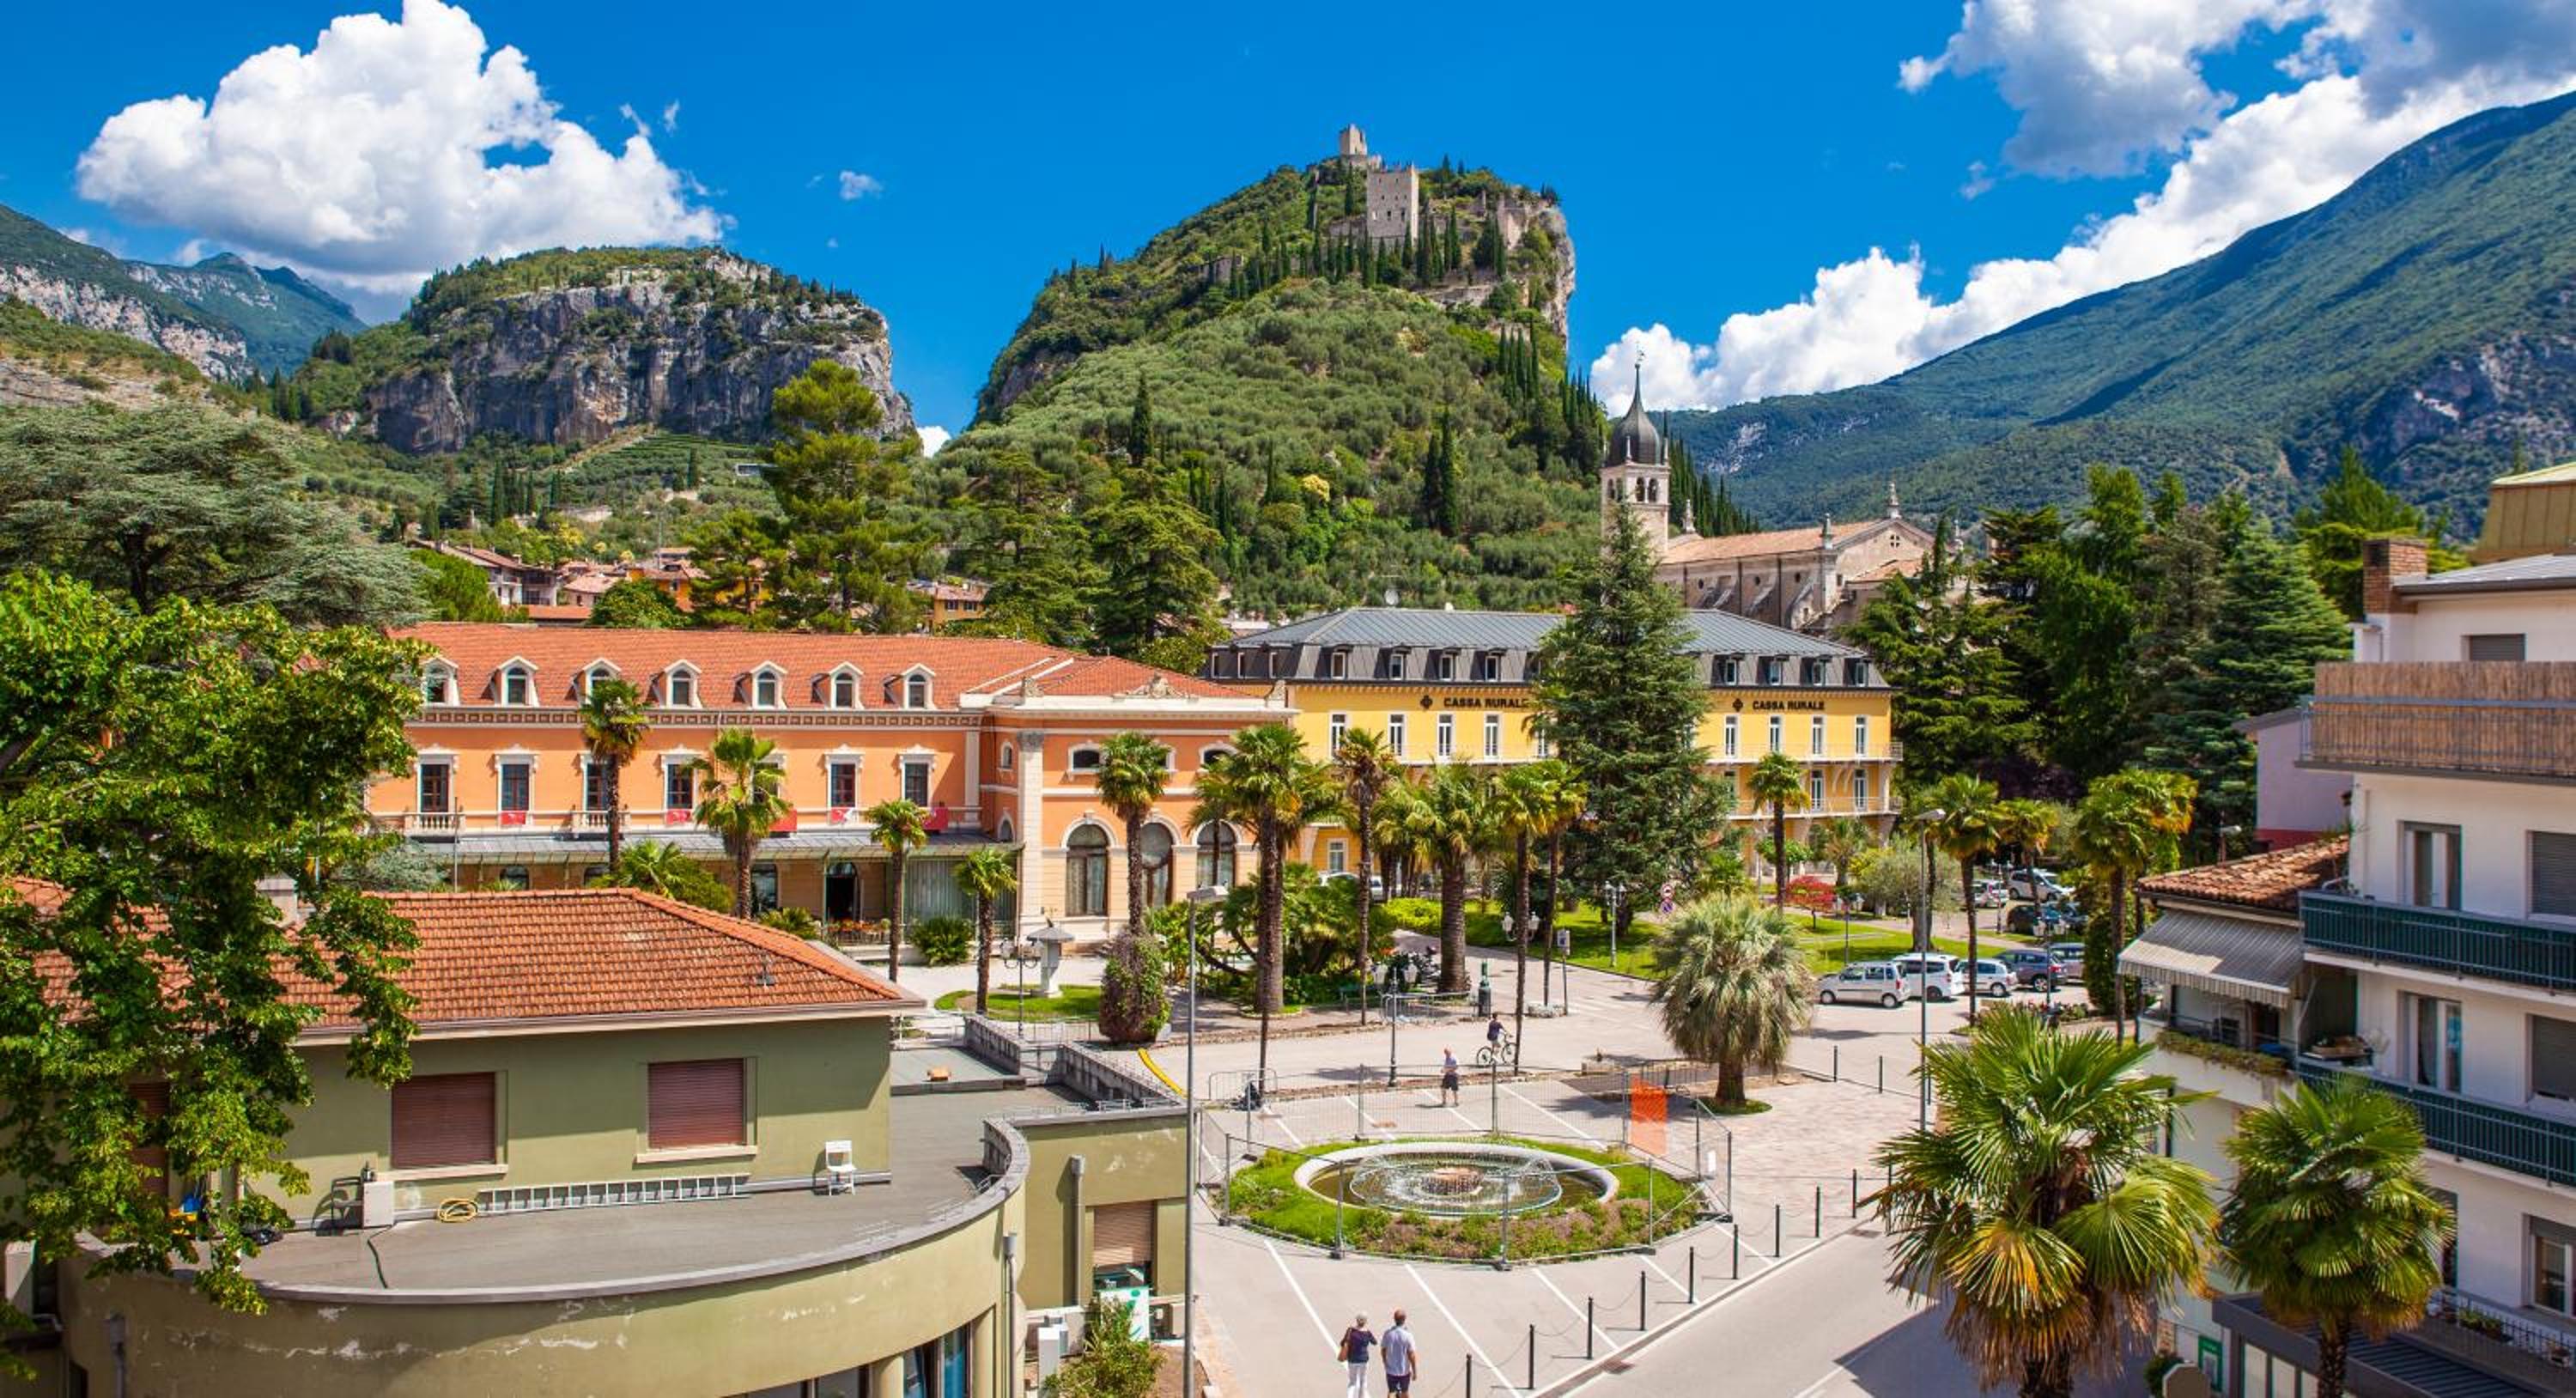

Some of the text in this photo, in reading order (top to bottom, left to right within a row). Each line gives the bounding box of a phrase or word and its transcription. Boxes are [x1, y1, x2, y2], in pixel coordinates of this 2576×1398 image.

[1443, 697, 1528, 708] CASSA RURALE
[1753, 701, 1825, 710] CASSA RURALE
